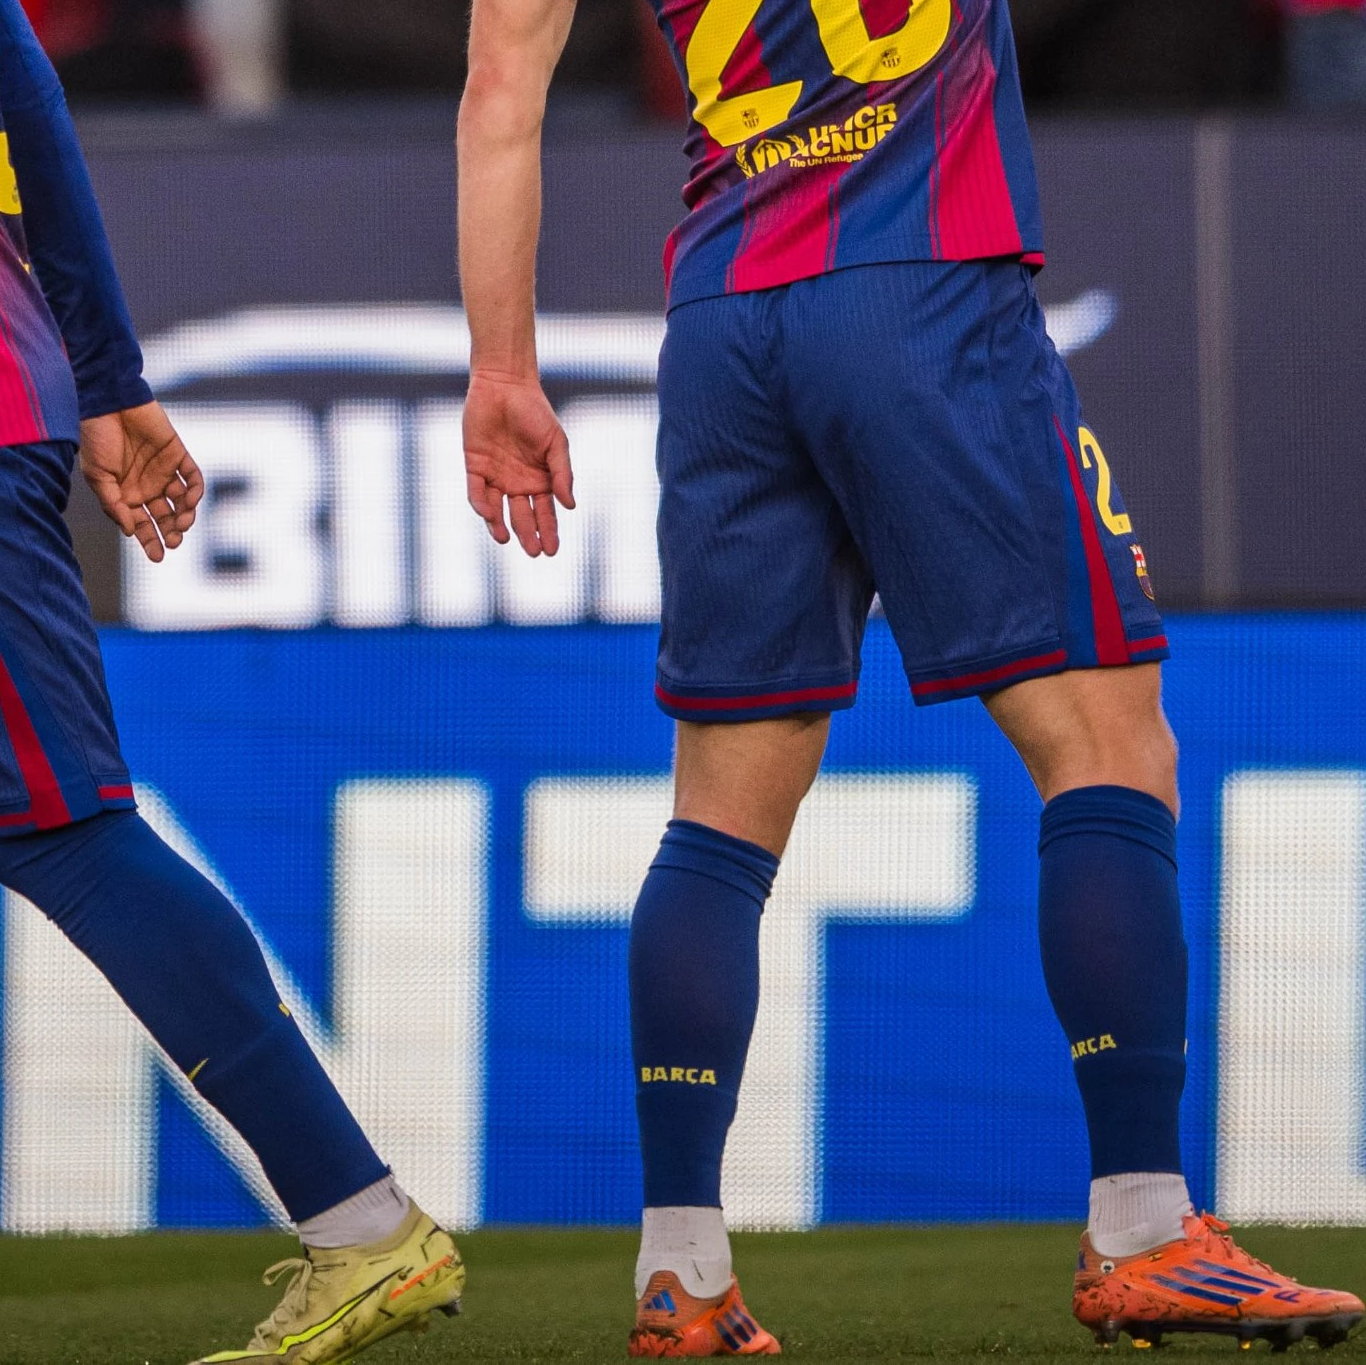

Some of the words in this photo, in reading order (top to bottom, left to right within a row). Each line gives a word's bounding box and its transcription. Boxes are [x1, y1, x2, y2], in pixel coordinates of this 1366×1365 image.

[788, 157, 806, 168] The
[807, 156, 823, 167] UN
[1071, 1034, 1117, 1062] ARÇA
[640, 1065, 718, 1086] BARÇA
